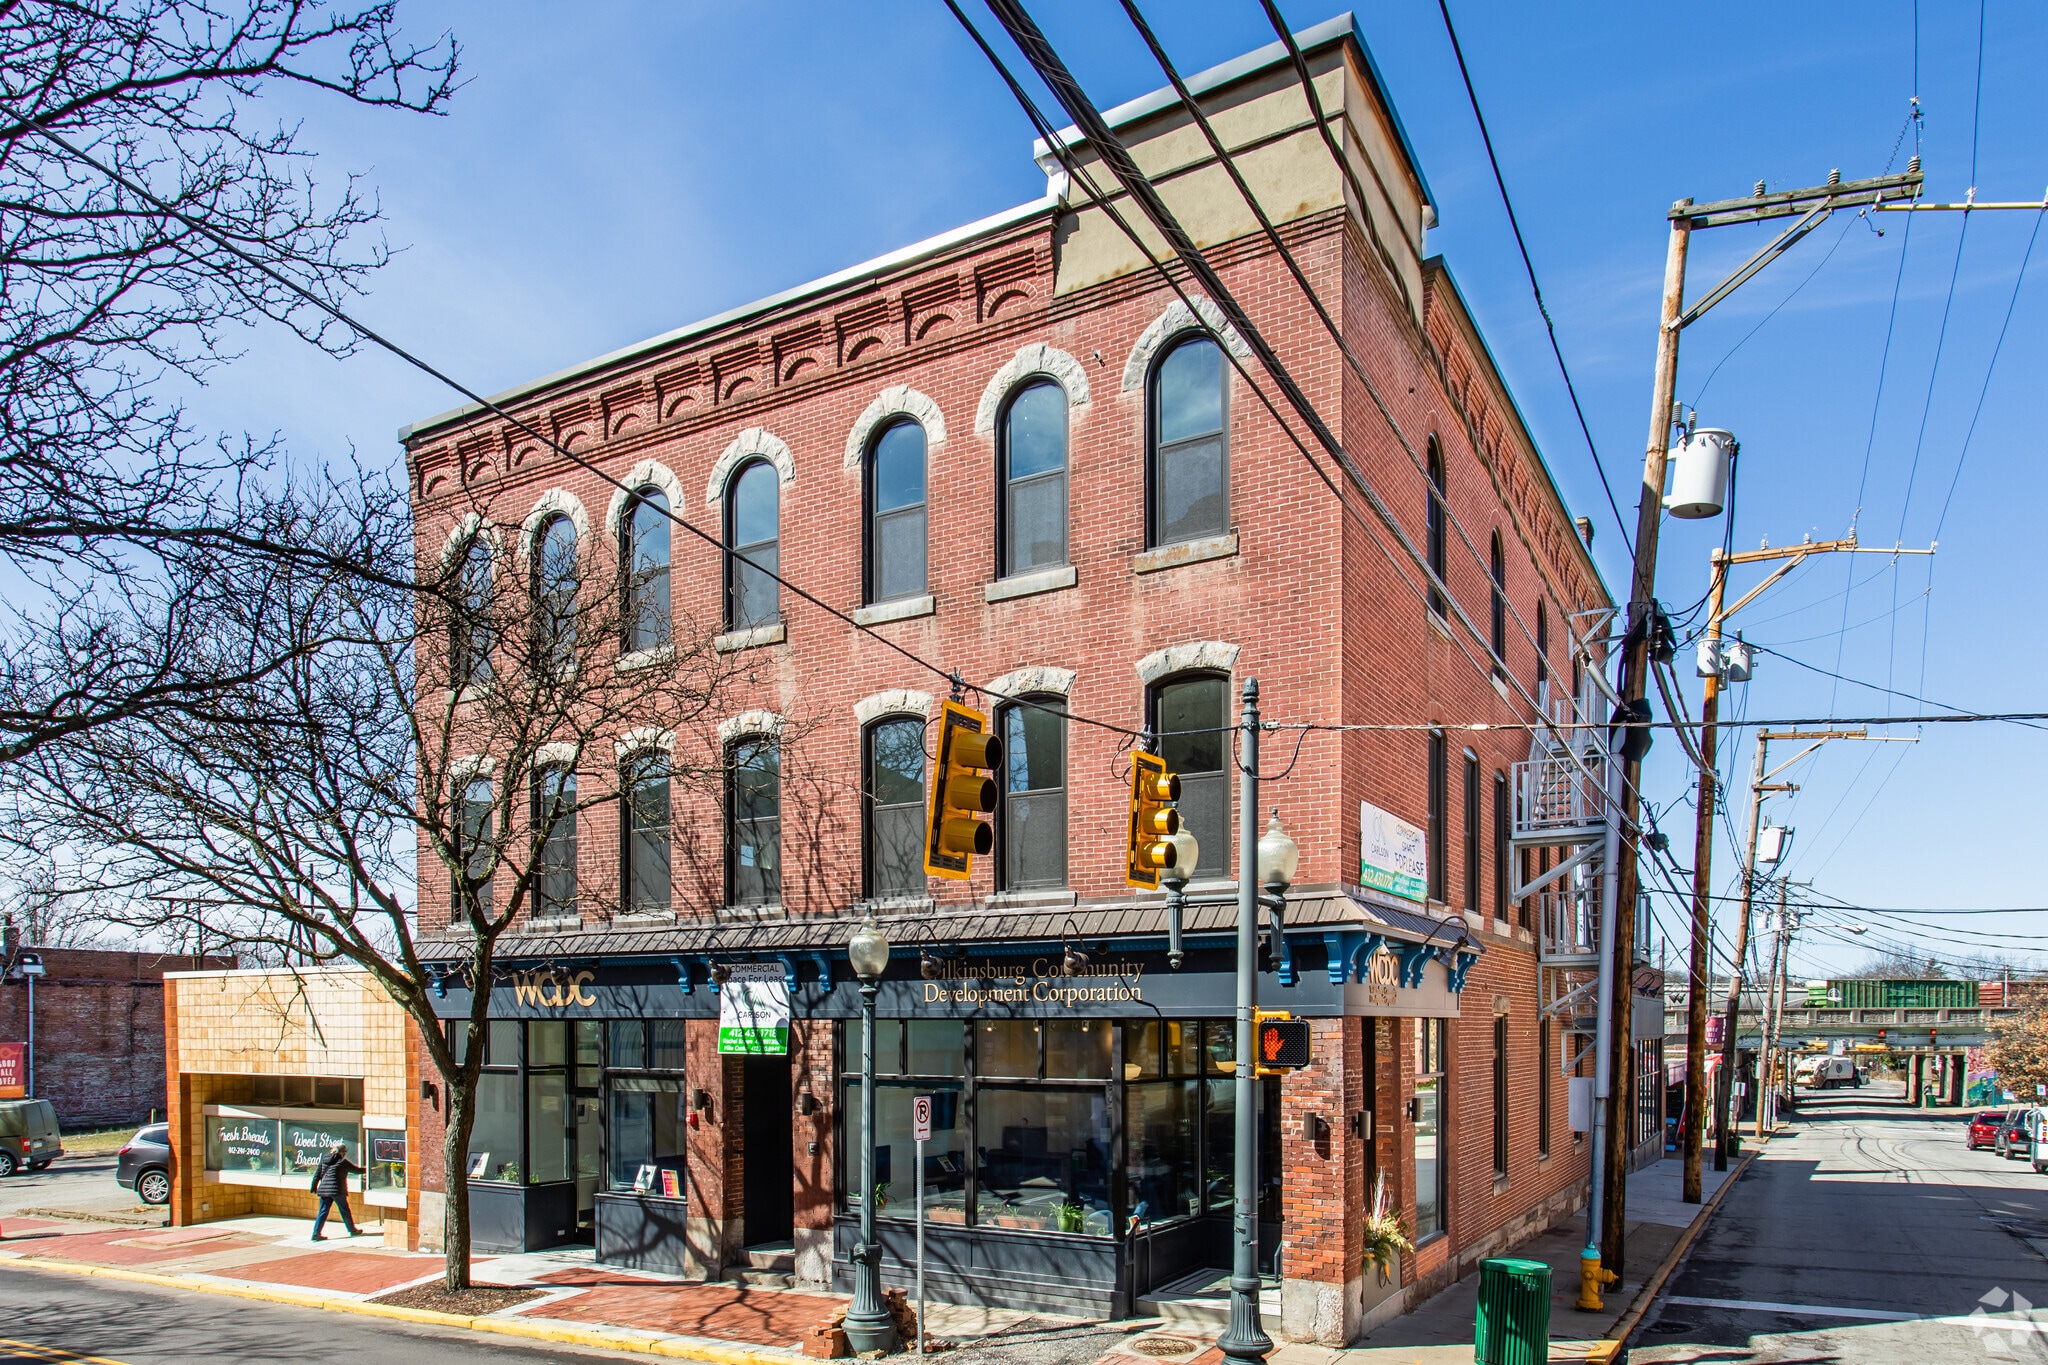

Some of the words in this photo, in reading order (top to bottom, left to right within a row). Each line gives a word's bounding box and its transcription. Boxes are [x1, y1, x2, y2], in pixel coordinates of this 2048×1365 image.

[1371, 843, 1390, 858] CARLSON
[731, 964, 780, 973] COMMERCIAL
[938, 959, 1026, 985] ilkinsburg
[728, 976, 745, 984] pace
[749, 974, 762, 983] For
[512, 970, 597, 1007] WCDC
[924, 982, 1030, 1008] Development
[1033, 981, 1143, 1008] Corporation
[738, 1011, 771, 1019] CARLSON
[1, 1068, 13, 1076] ALL
[217, 1126, 240, 1144] Fresh
[241, 1126, 271, 1145] Breads
[293, 1132, 318, 1147] Wood
[295, 1150, 322, 1166] Bread
[376, 1141, 405, 1160] OPEN
